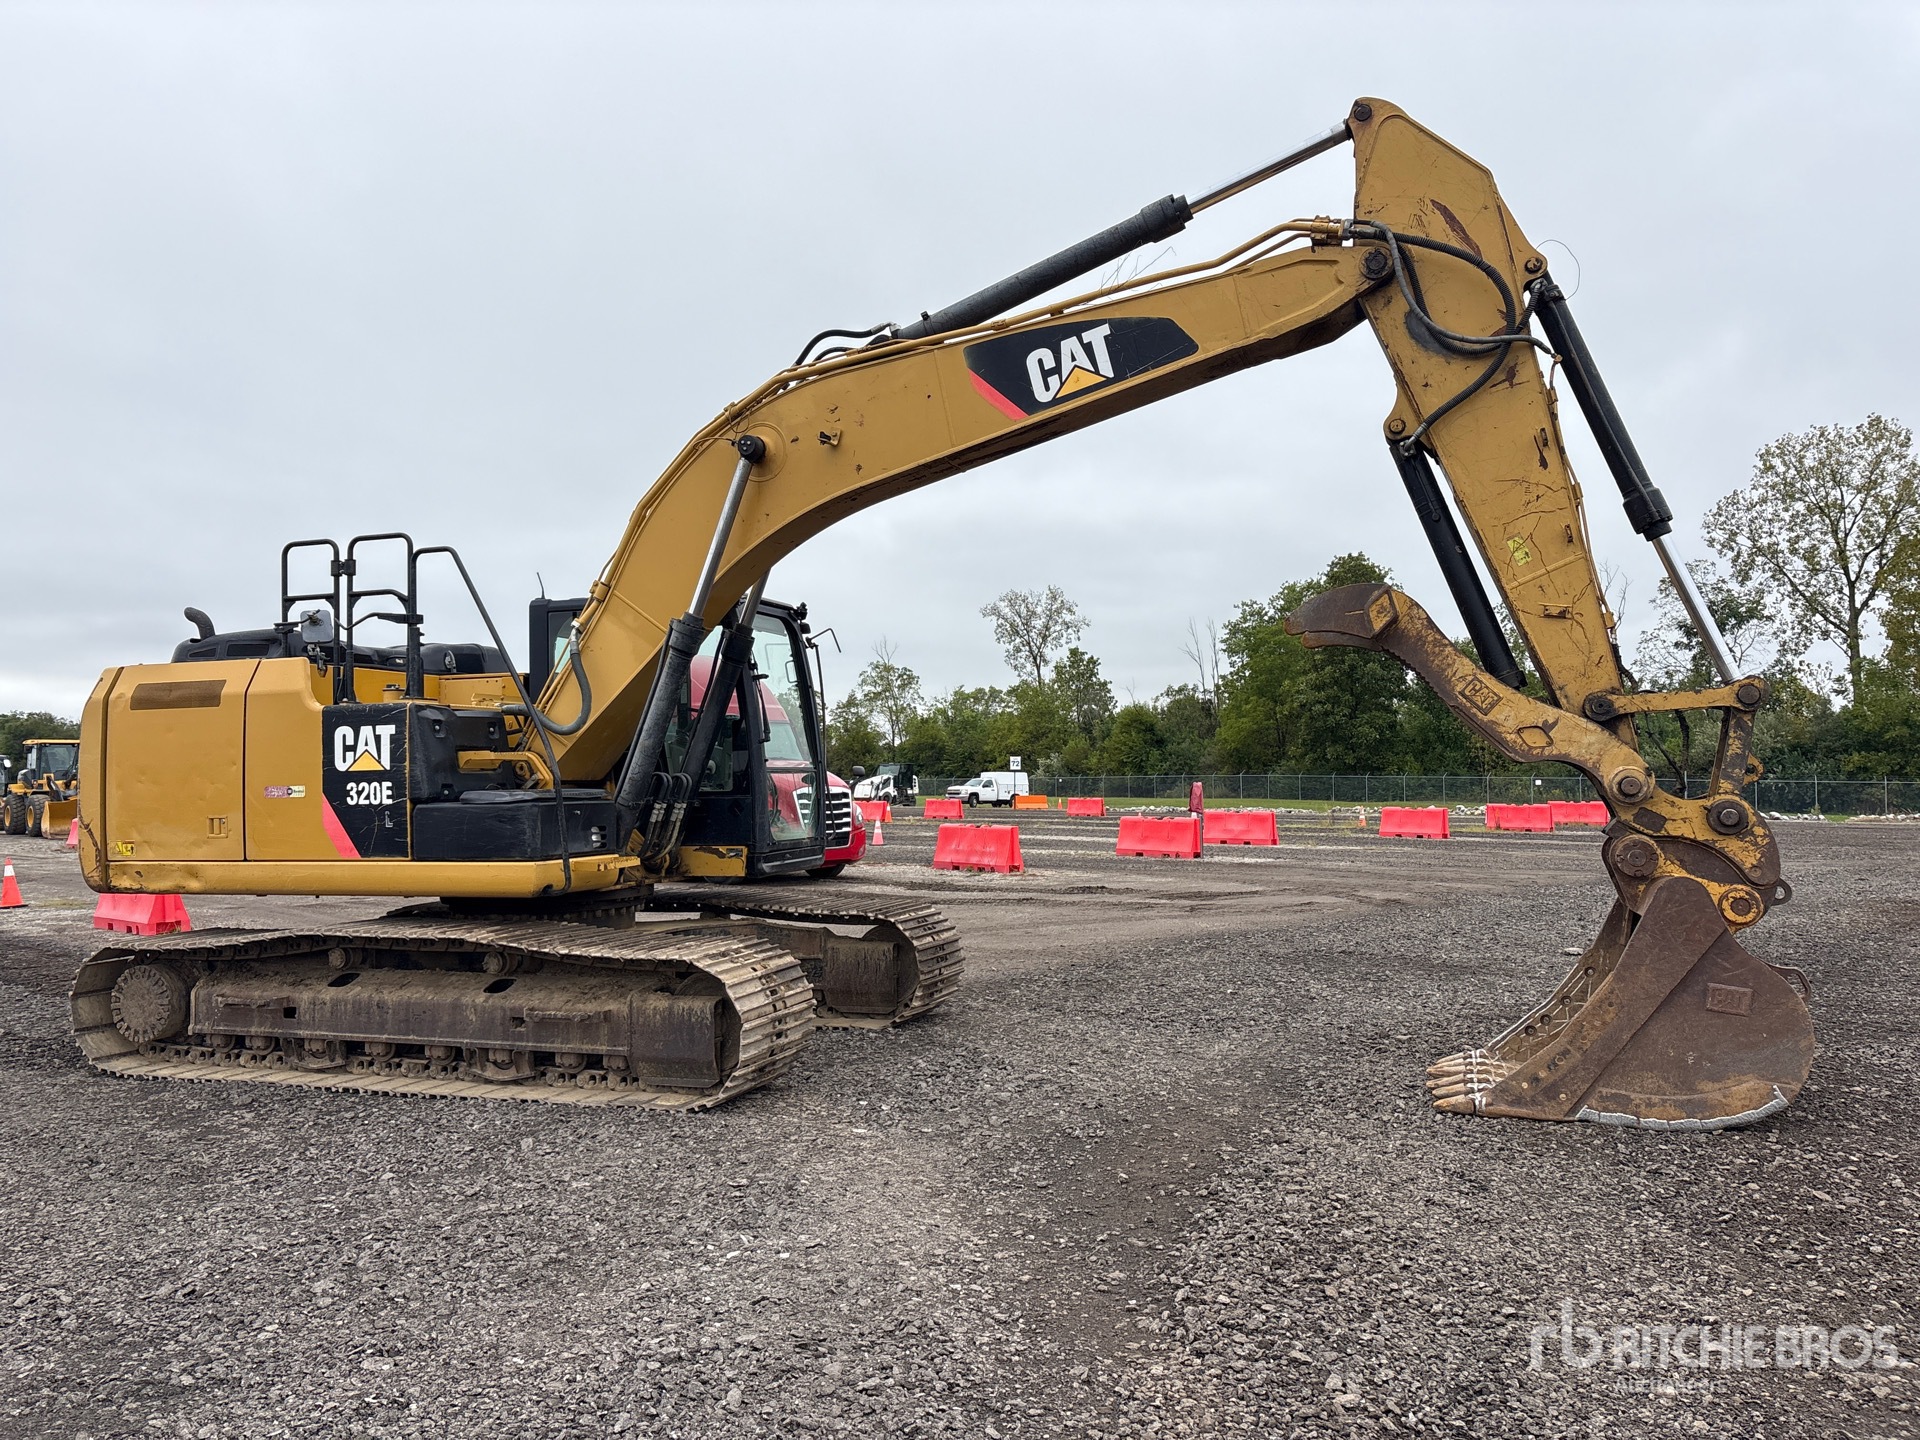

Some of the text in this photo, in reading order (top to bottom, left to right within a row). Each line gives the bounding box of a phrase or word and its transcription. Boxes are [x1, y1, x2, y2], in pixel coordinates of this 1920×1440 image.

[1026, 323, 1114, 402] CAT
[1464, 680, 1498, 709] CAT
[334, 725, 395, 771] CAT
[346, 781, 393, 805] 320E
